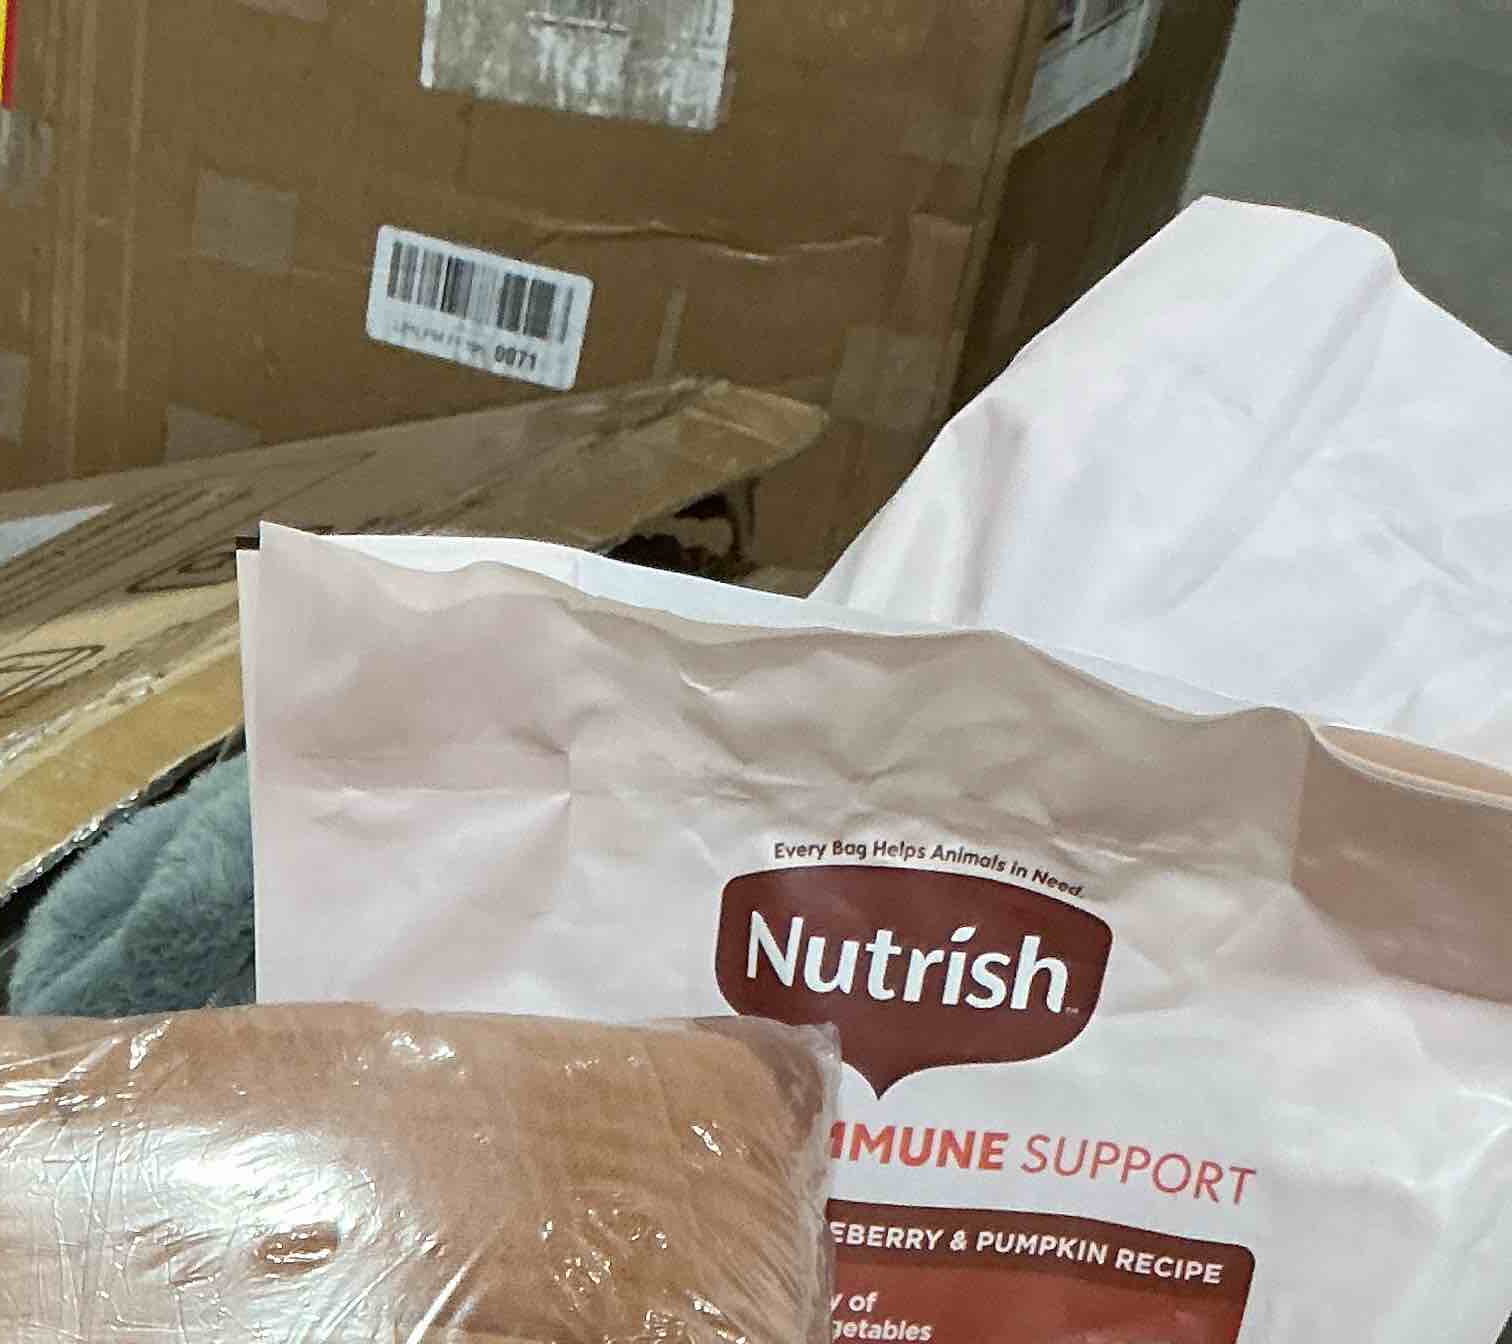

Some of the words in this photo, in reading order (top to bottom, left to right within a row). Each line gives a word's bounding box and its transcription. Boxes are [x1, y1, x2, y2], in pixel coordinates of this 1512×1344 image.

[775, 840, 827, 861] Every
[832, 840, 867, 861] Bag
[873, 840, 926, 862] Helps
[931, 844, 1006, 873] Animals
[1010, 859, 1028, 879] in
[746, 910, 1069, 1014] Nutrish
[1020, 1134, 1257, 1206] SUPPORT
[949, 1231, 968, 1252] &
[975, 1230, 1108, 1265] PUMPKIN
[1115, 1247, 1225, 1285] RECIPE
[848, 1290, 879, 1313] of
